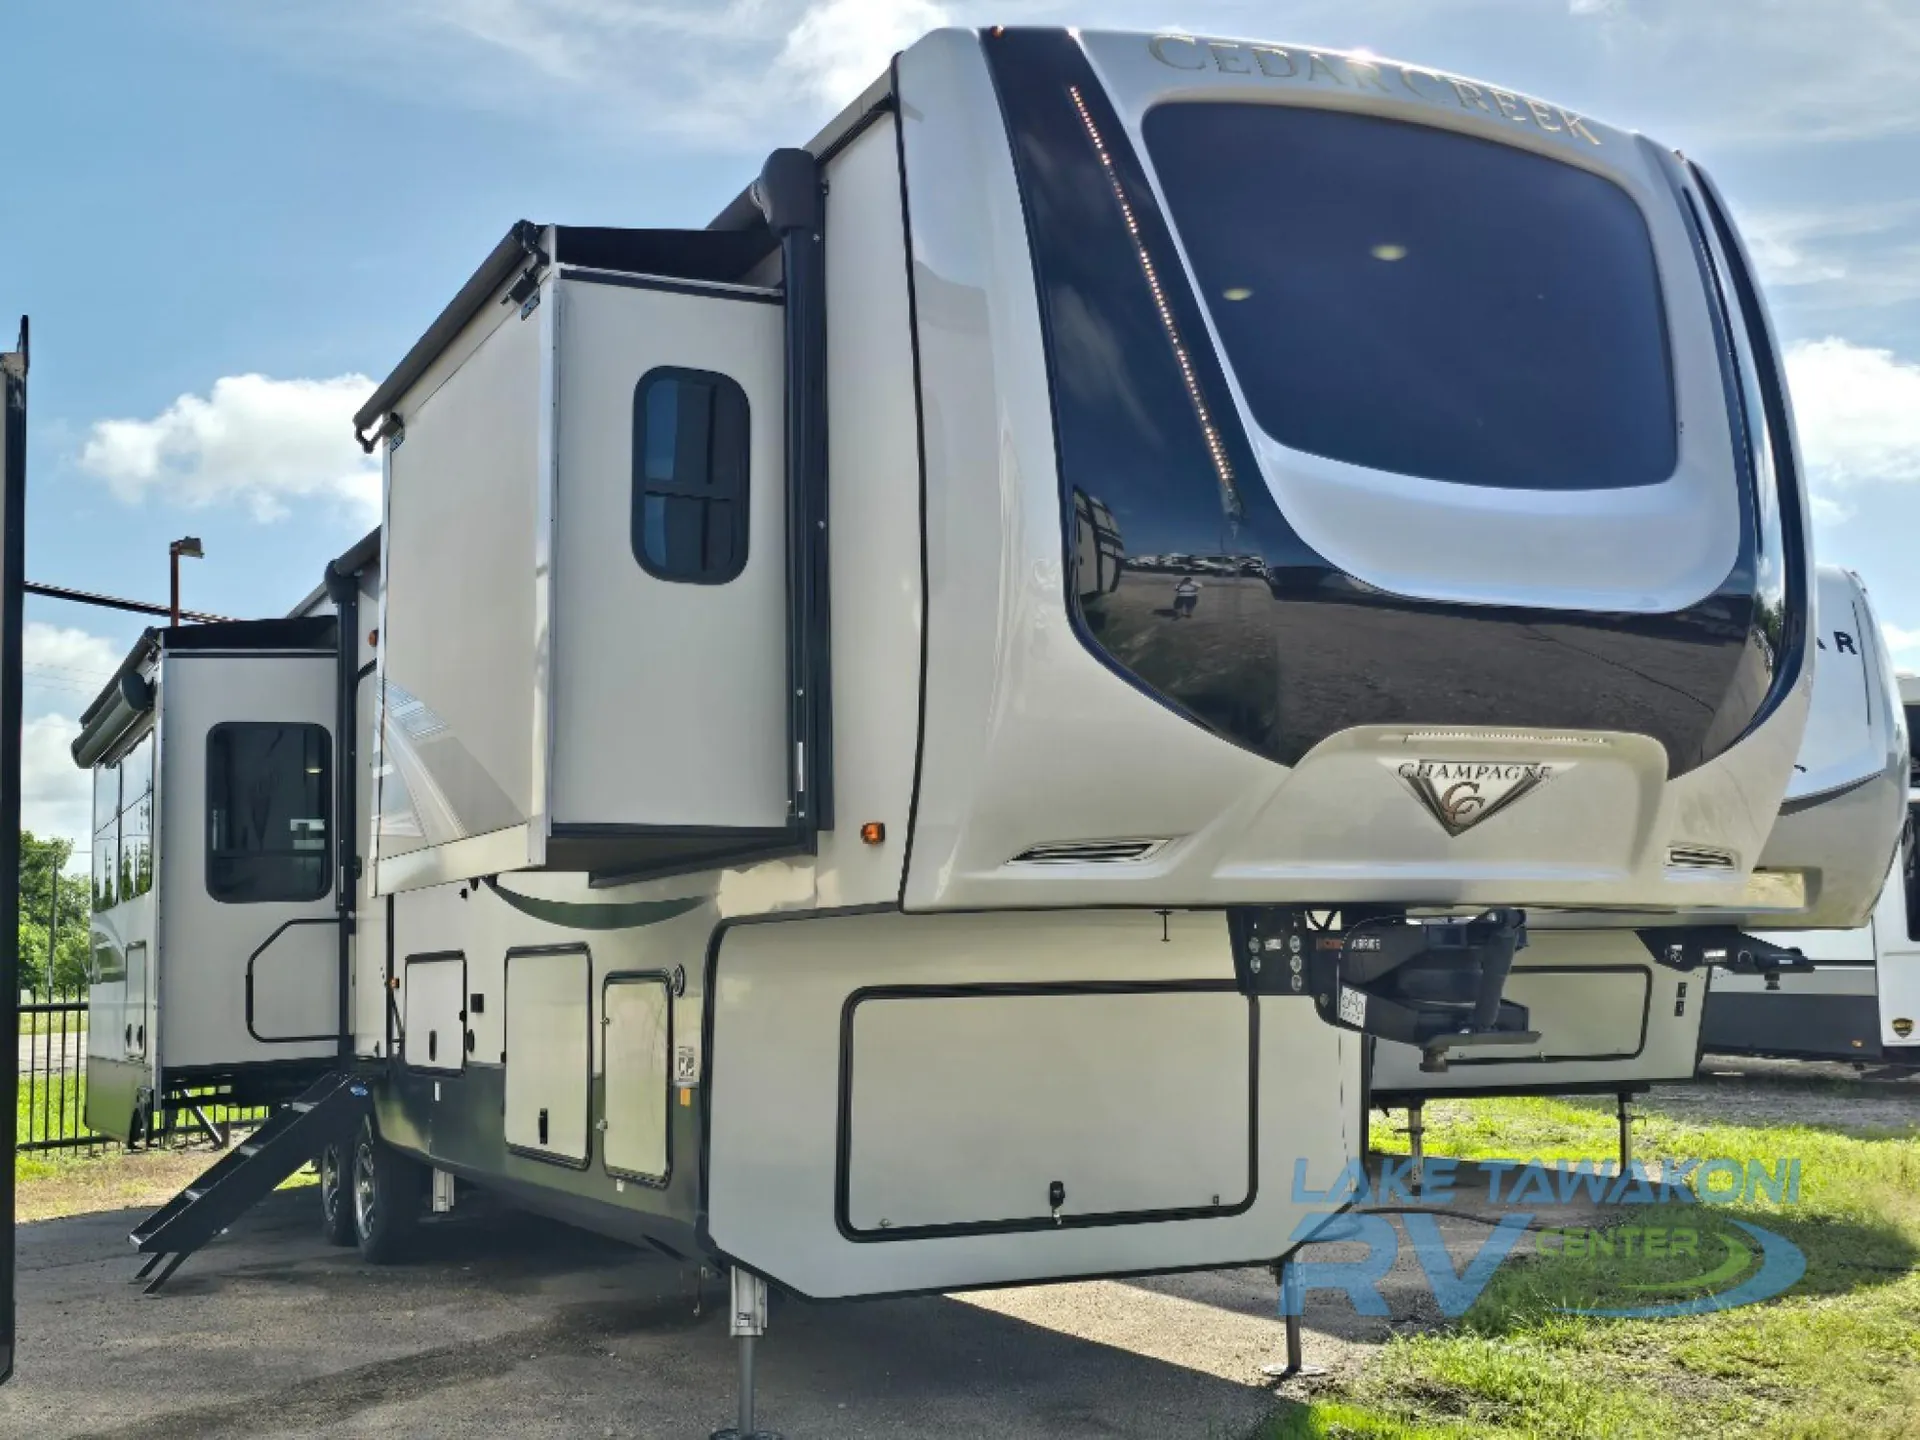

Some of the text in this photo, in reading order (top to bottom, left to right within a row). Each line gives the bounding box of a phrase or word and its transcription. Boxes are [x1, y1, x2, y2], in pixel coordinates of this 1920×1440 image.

[1147, 33, 1602, 146] CEDAR CREEK
[1398, 762, 1553, 782] CHAMPAGNE
